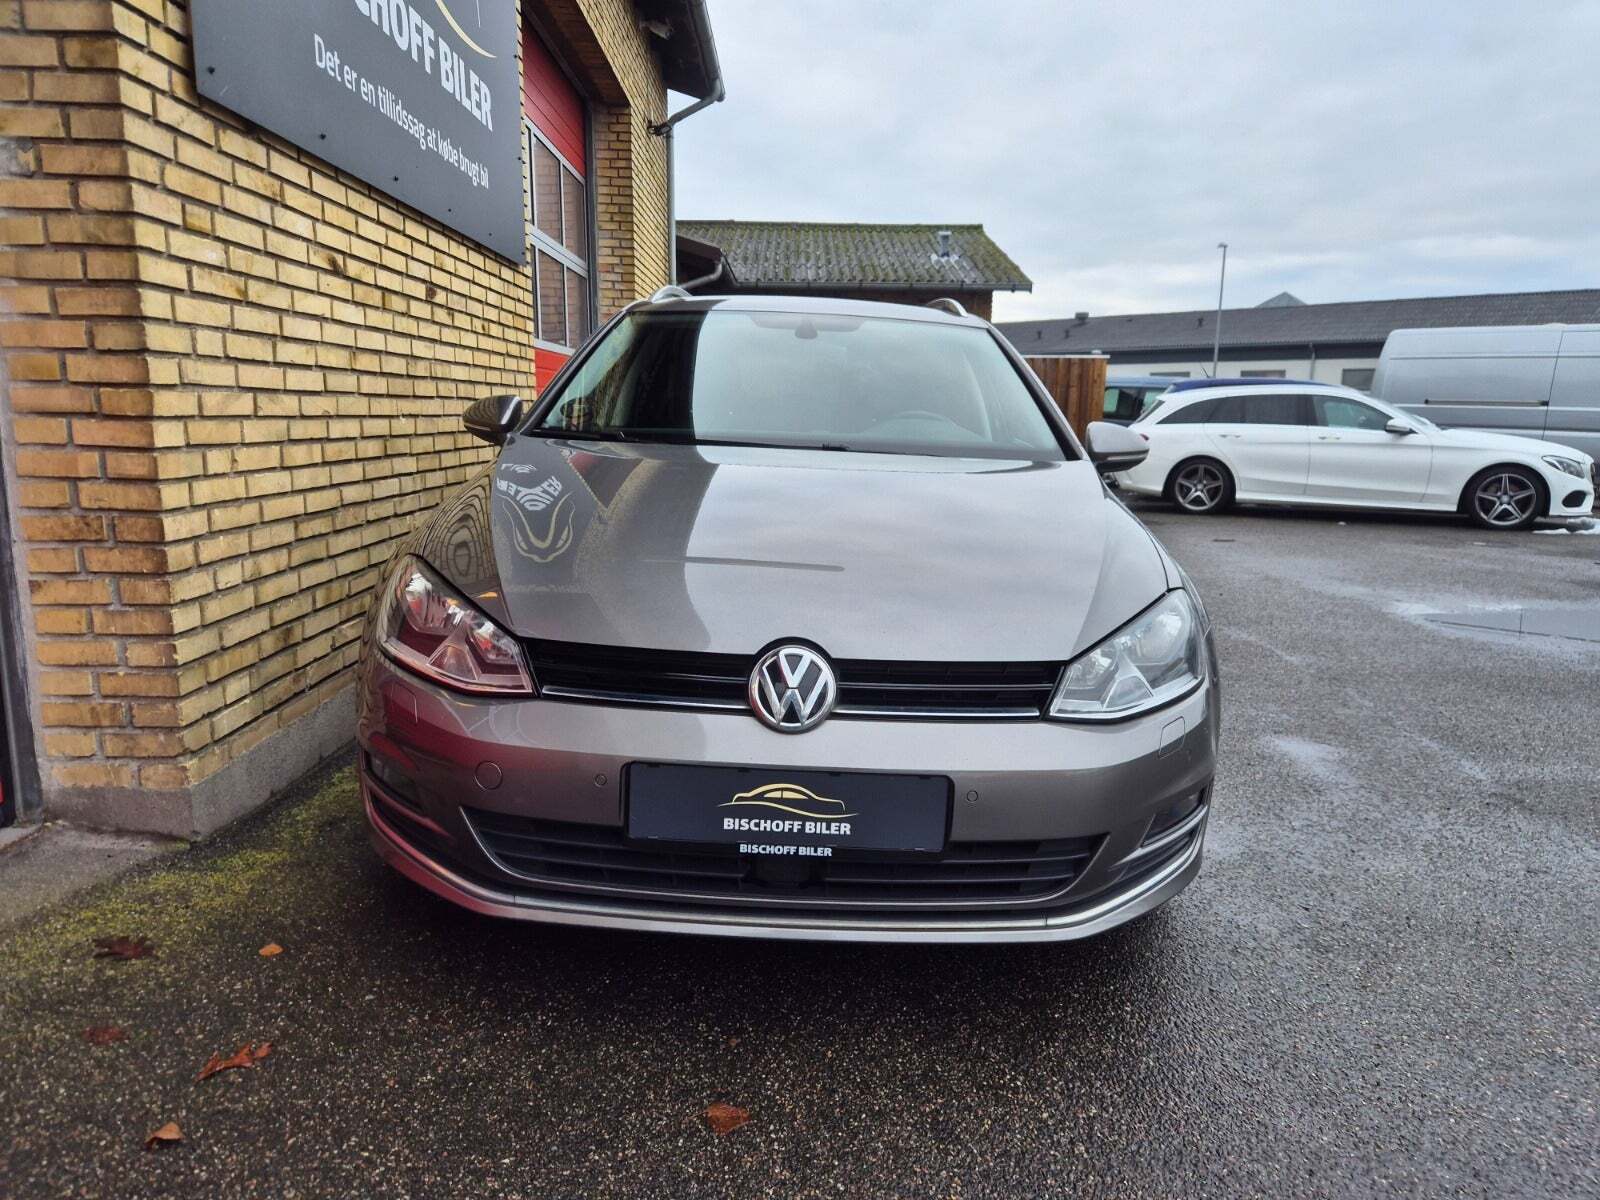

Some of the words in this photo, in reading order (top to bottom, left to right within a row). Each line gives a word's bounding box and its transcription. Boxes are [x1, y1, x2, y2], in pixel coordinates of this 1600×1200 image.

[314, 33, 341, 82] Det
[343, 65, 357, 92] er
[360, 77, 376, 107] en
[378, 85, 426, 151] tillidssag
[427, 127, 437, 152] at
[438, 130, 459, 168] købe
[459, 146, 480, 187] brugt
[438, 36, 493, 132] BILER
[754, 648, 832, 730] VW
[723, 817, 803, 833] BISCHOFF
[804, 821, 852, 835] BILER
[739, 843, 798, 855] BISCHOFF
[798, 846, 833, 857] BILER
